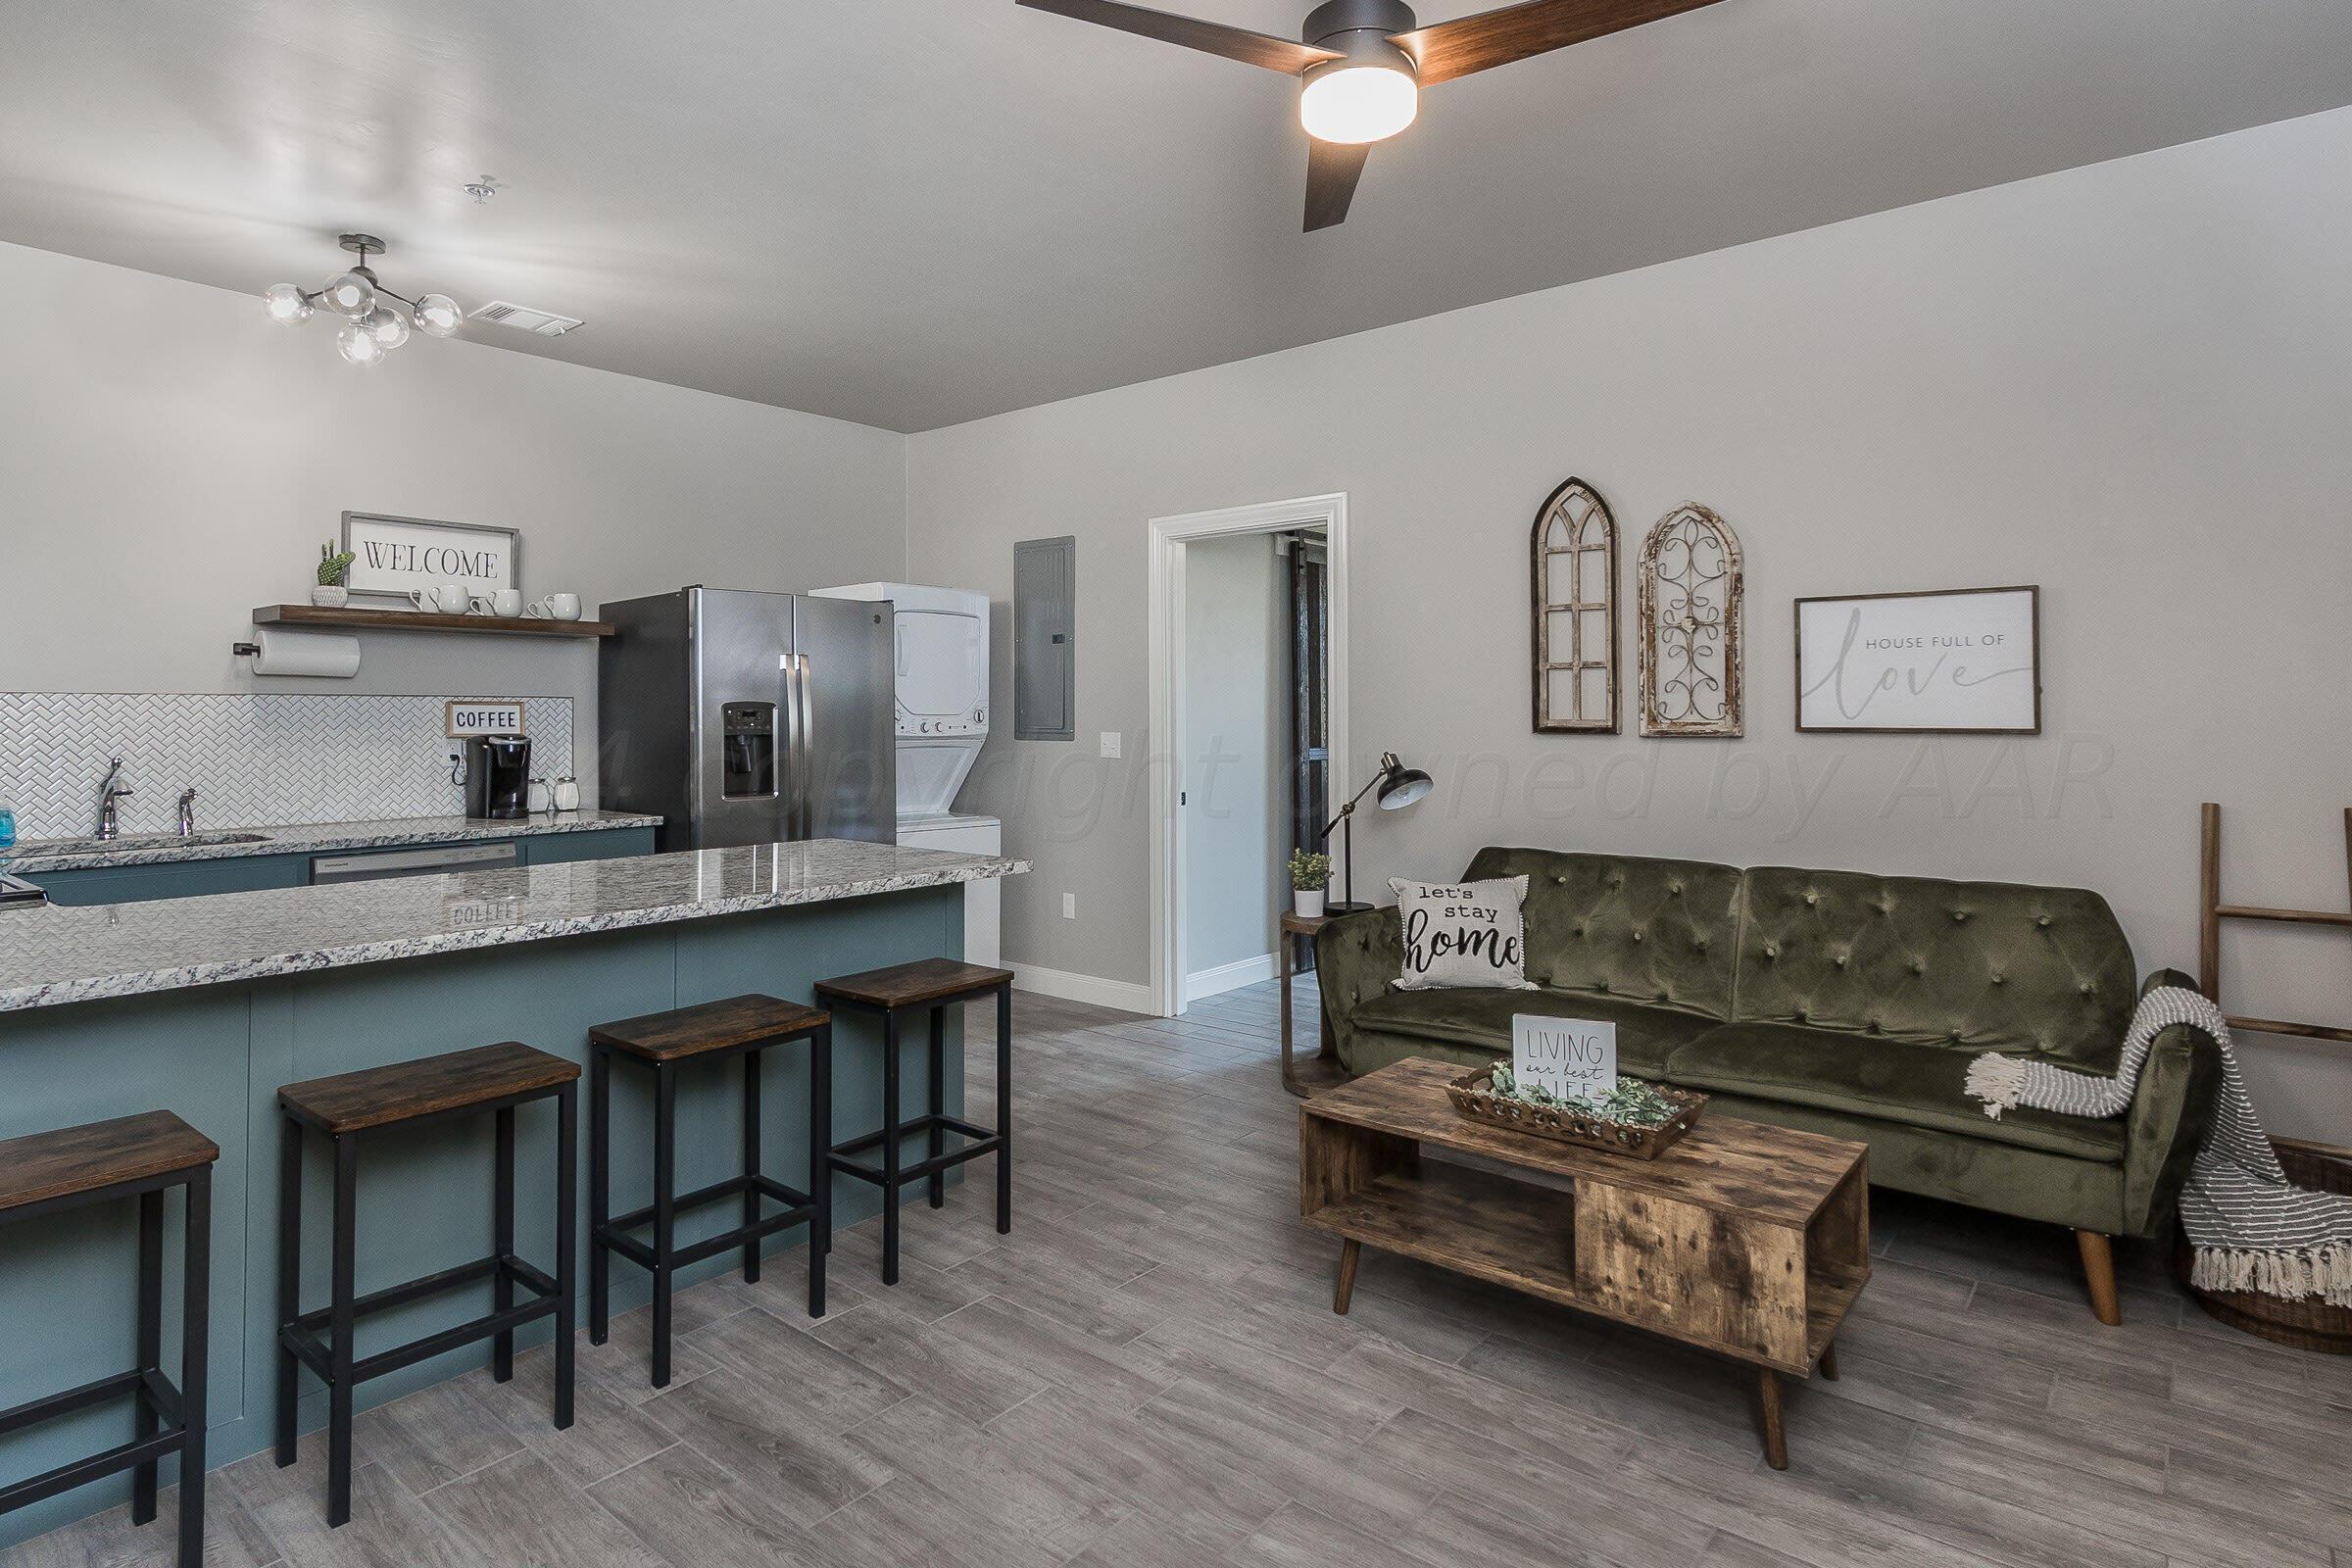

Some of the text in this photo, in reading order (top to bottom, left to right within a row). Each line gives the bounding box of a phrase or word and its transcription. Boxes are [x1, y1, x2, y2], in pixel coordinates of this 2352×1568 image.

[364, 541, 498, 578] WELCOME
[1866, 634, 2007, 650] HOUSE FULL OF
[456, 711, 516, 727] COFFEE
[1419, 886, 1473, 899] let's
[1445, 905, 1497, 923] stay
[1405, 908, 1520, 973] home
[1527, 1029, 1603, 1064] LIVING
[1563, 1062, 1605, 1080] best
